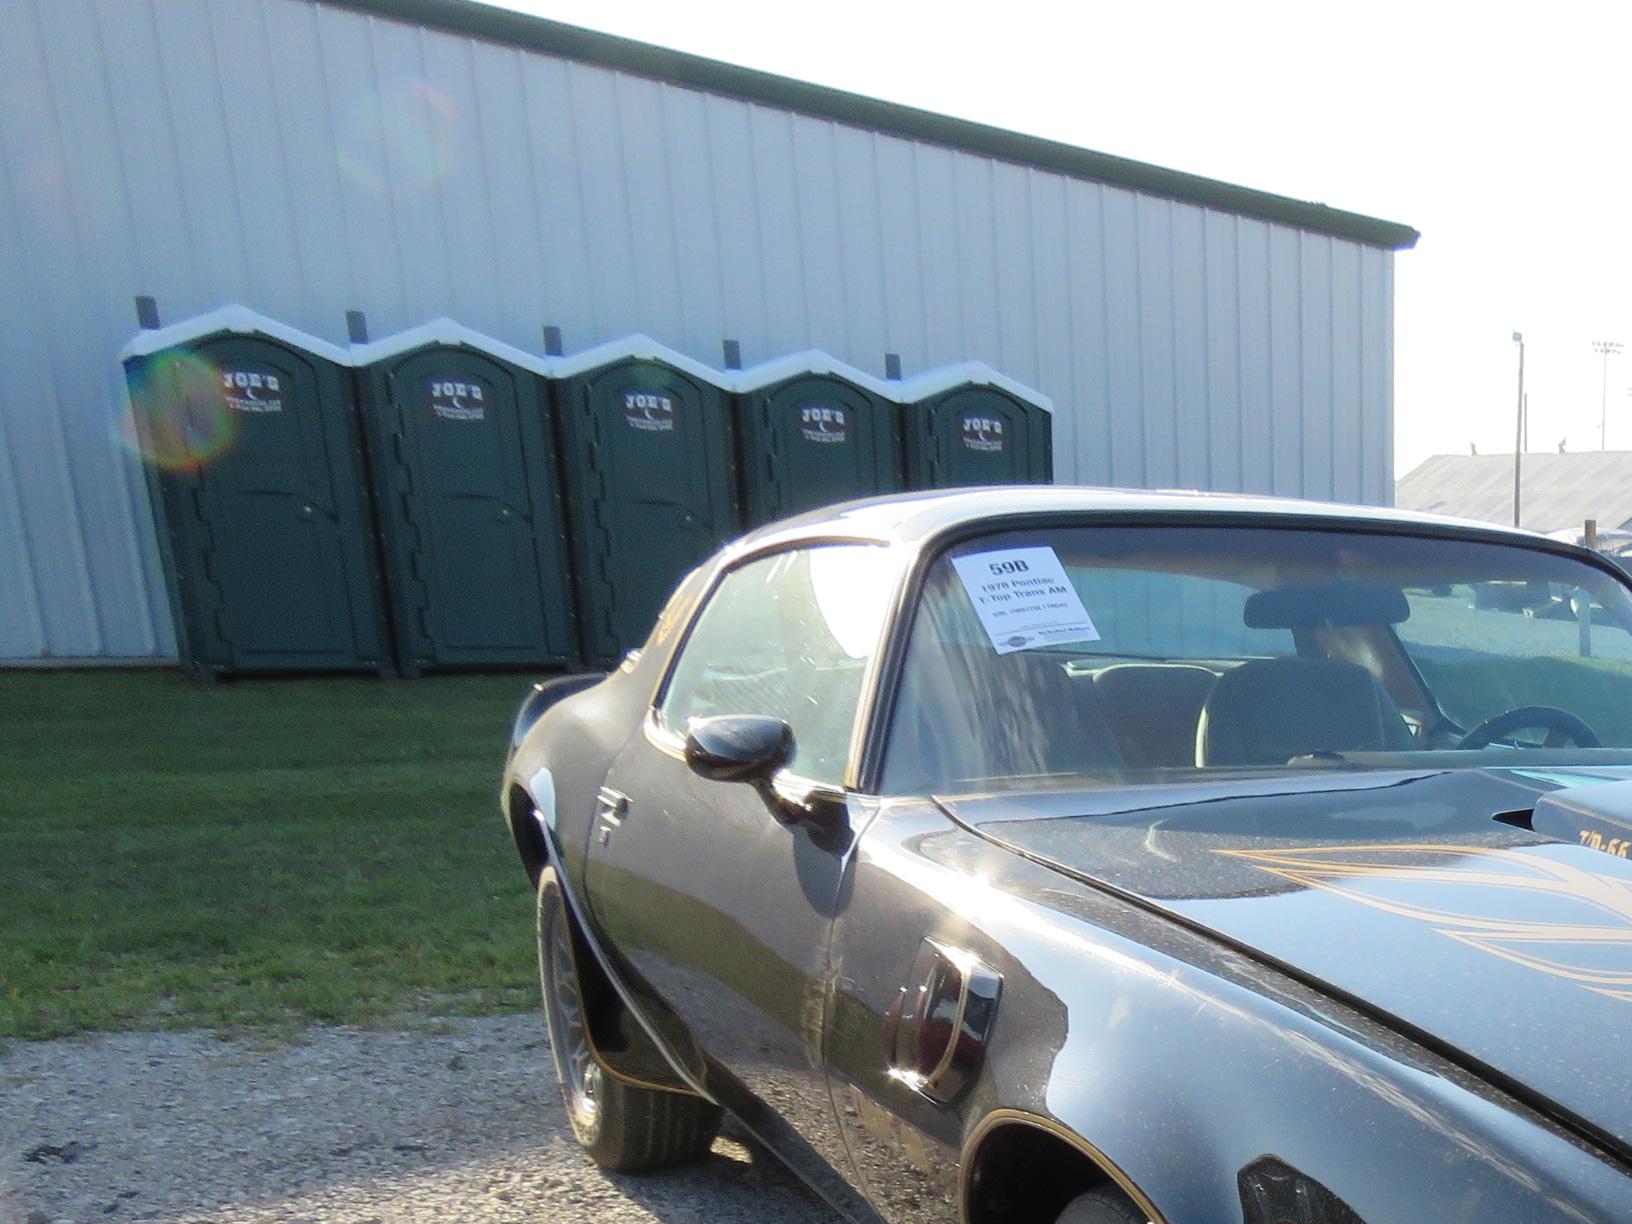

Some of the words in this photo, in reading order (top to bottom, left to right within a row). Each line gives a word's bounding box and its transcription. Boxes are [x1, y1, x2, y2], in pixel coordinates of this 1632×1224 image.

[988, 560, 1030, 576] 59B
[1011, 577, 1055, 588] Pontiac
[1013, 588, 1046, 599] Trans
[1048, 585, 1069, 595] AM
